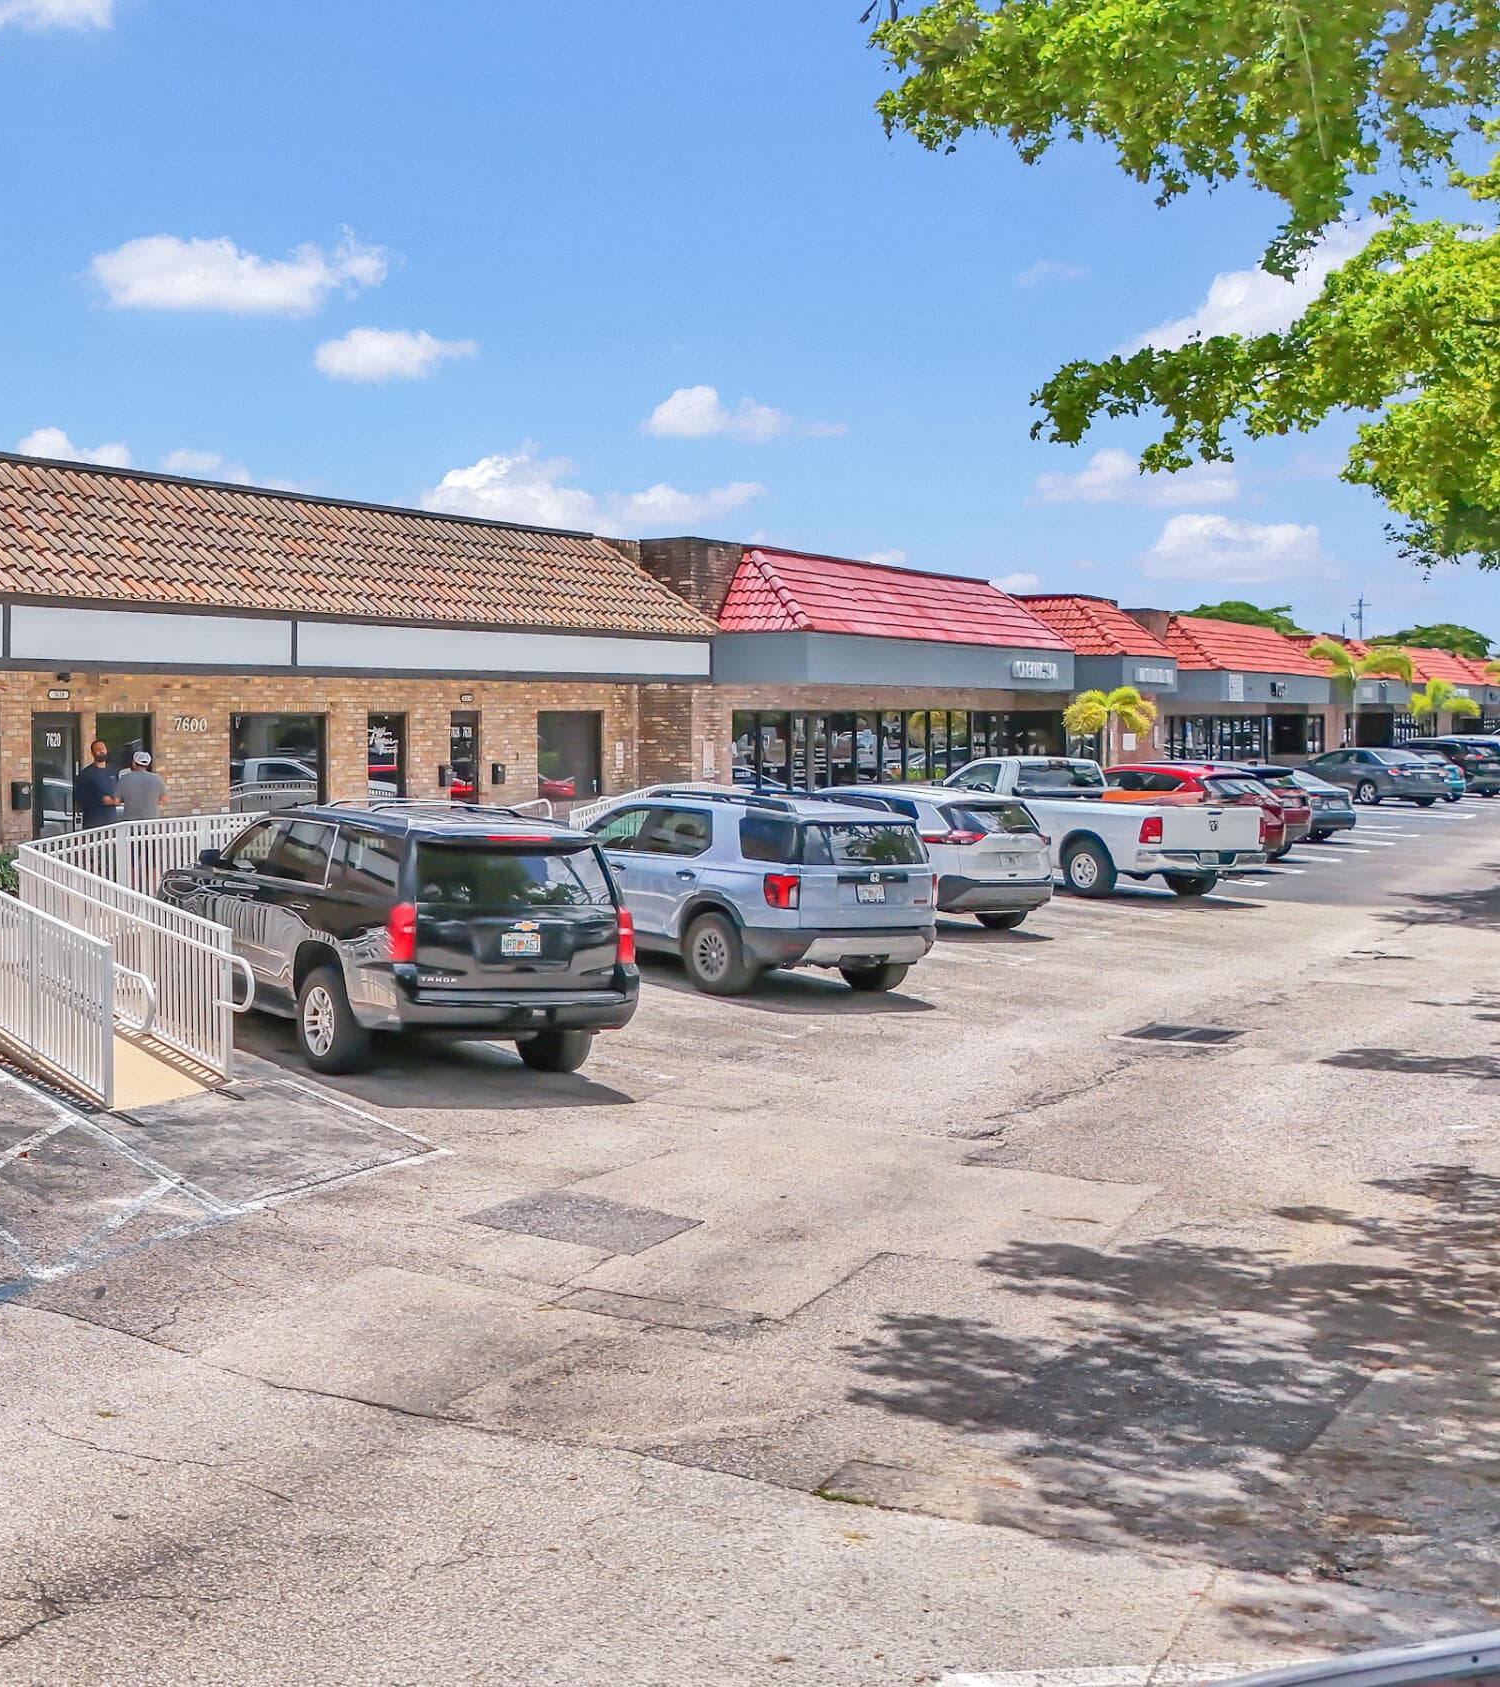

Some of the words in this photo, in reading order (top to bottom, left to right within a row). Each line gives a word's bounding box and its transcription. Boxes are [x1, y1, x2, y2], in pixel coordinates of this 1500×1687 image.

[174, 717, 208, 732] 7600
[46, 732, 61, 747] 7620
[420, 976, 457, 984] TAHOE
